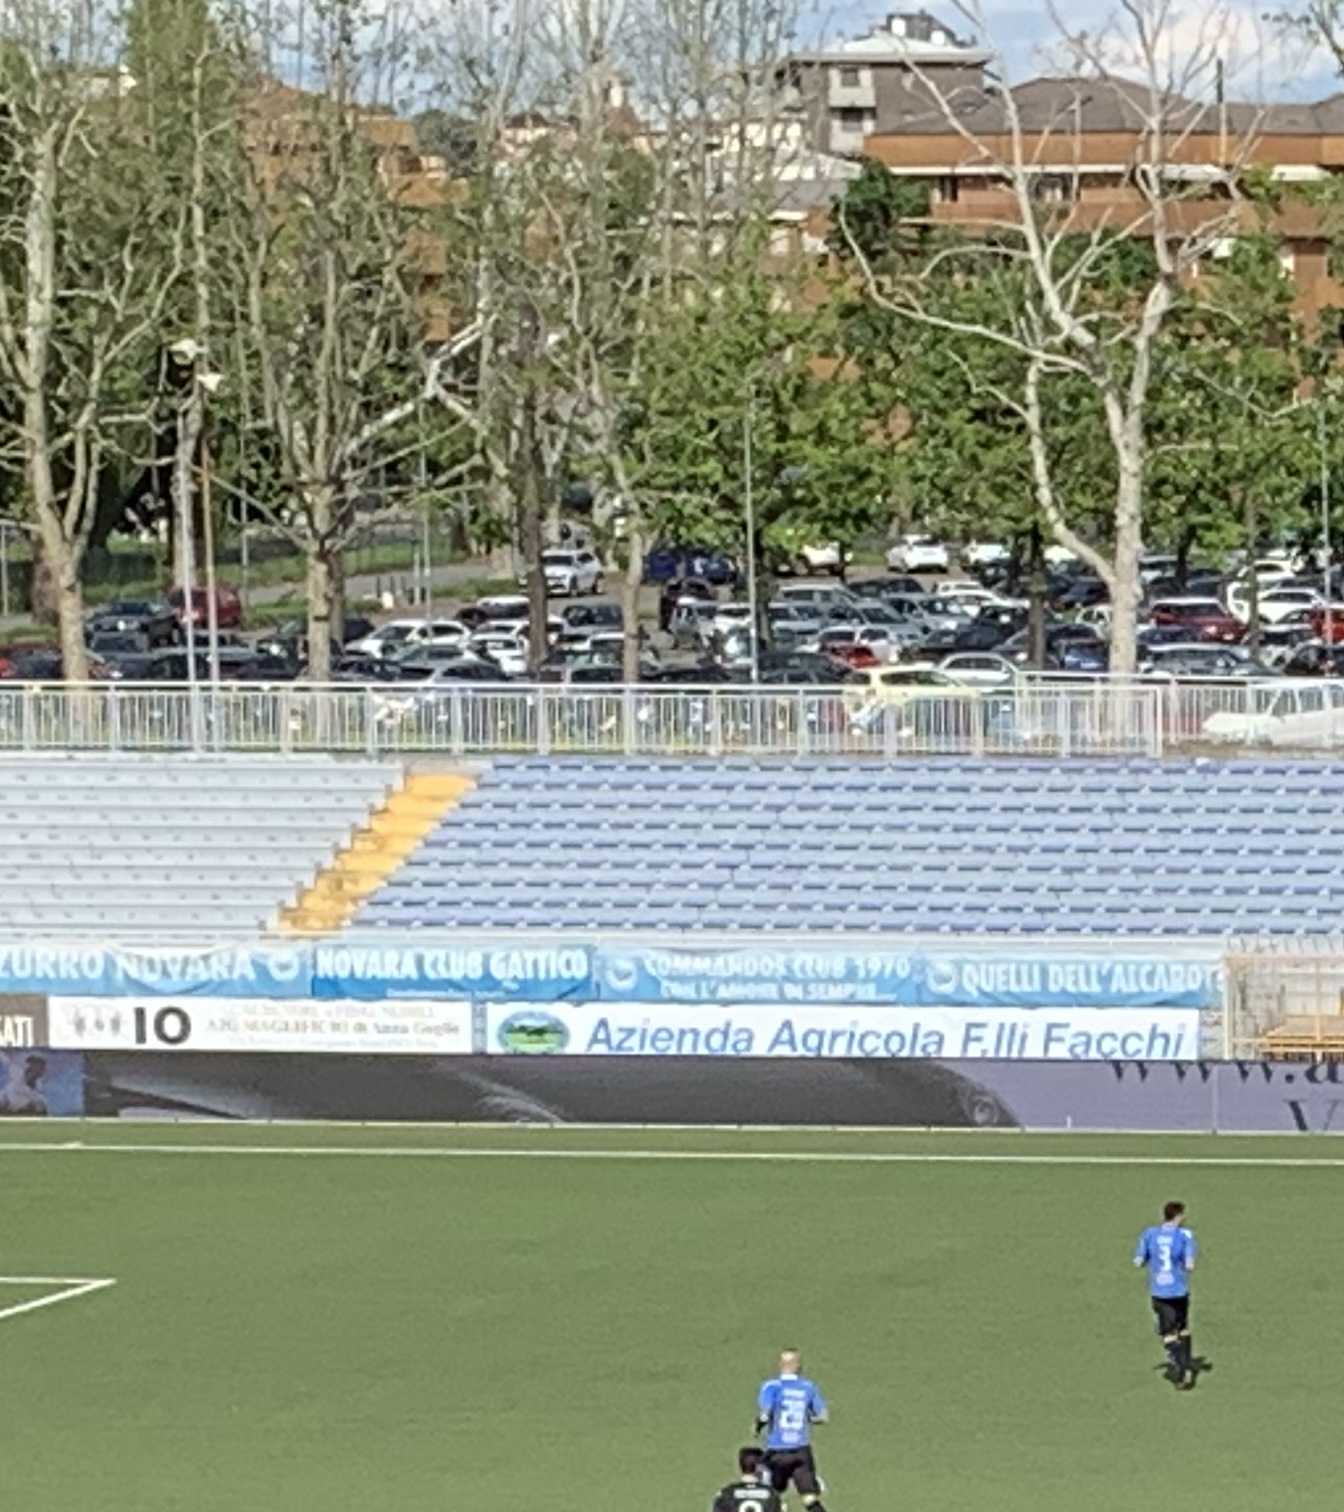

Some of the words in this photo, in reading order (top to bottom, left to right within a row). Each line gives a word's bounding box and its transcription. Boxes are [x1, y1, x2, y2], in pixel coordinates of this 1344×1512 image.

[116, 950, 257, 981] NOVARA
[316, 949, 419, 979] NOVARA
[422, 950, 483, 979] CLUB
[489, 950, 588, 980] GATTICO
[856, 956, 912, 980] 1970
[963, 961, 1042, 996] QUELLI
[586, 1018, 755, 1054] Azienda
[767, 1019, 945, 1057] Agricola
[1043, 1022, 1187, 1059] Facchi
